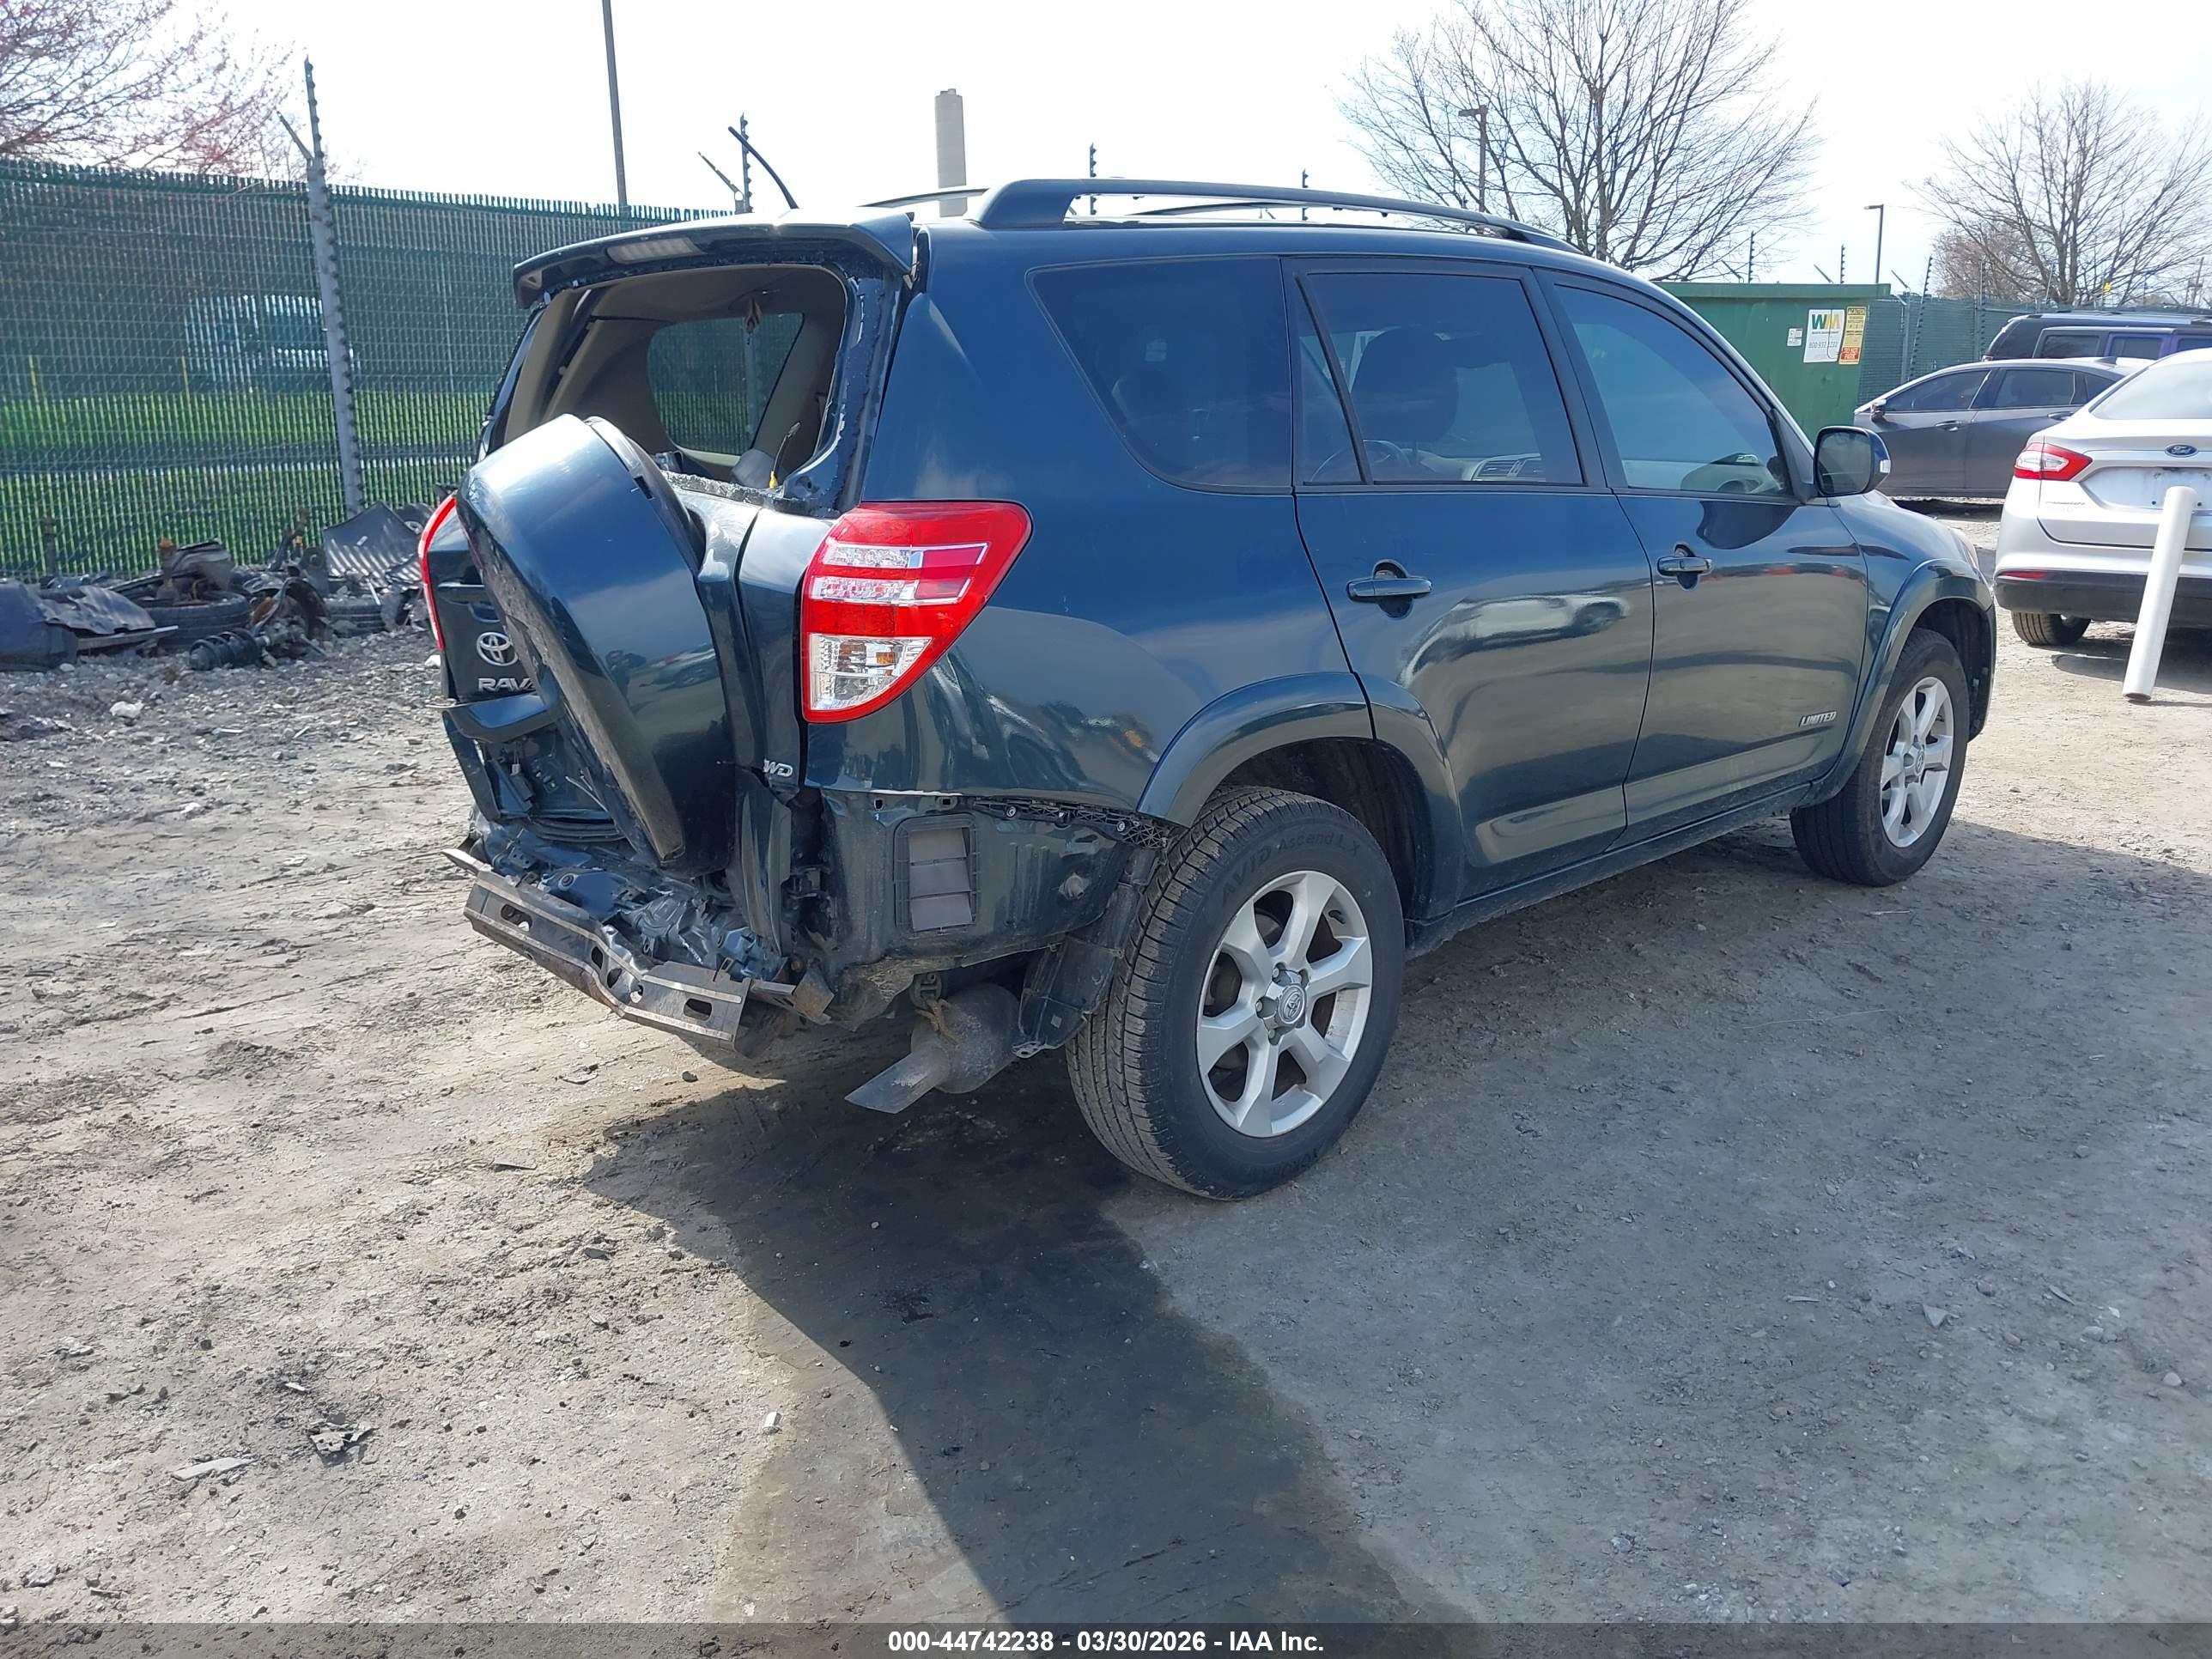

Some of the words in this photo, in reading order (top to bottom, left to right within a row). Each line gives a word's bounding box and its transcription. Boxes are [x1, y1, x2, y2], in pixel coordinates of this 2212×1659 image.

[1812, 314, 1842, 330] WM
[1800, 711, 1837, 726] LIMITED
[1278, 831, 1334, 853] Ascend
